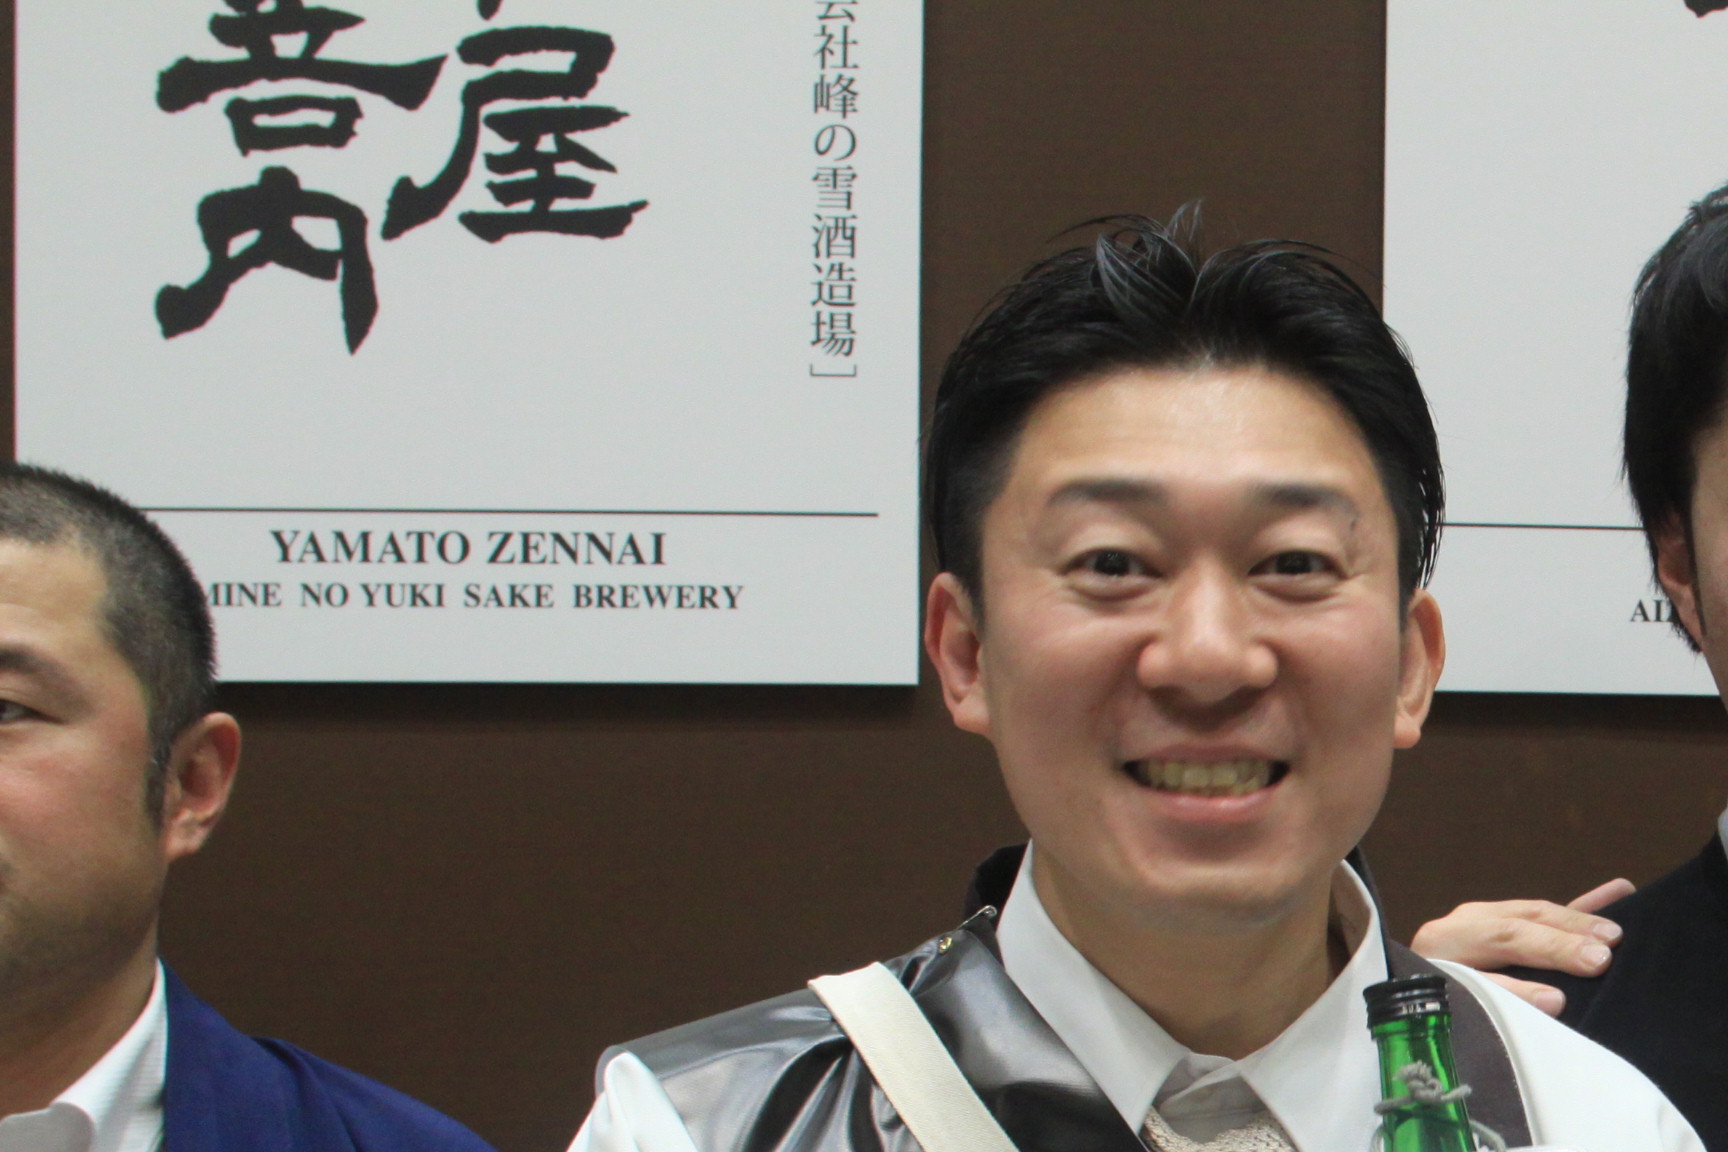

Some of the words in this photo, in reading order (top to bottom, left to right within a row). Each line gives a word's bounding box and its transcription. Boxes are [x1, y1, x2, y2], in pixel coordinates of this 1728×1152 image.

[382, 0, 650, 242] 屋
[270, 530, 472, 565] YAMATO
[486, 532, 668, 567] ZENNAI
[301, 583, 350, 609] NO
[361, 583, 446, 609] YUKI
[463, 583, 554, 611] SAKE
[572, 584, 744, 612] BREWERY
